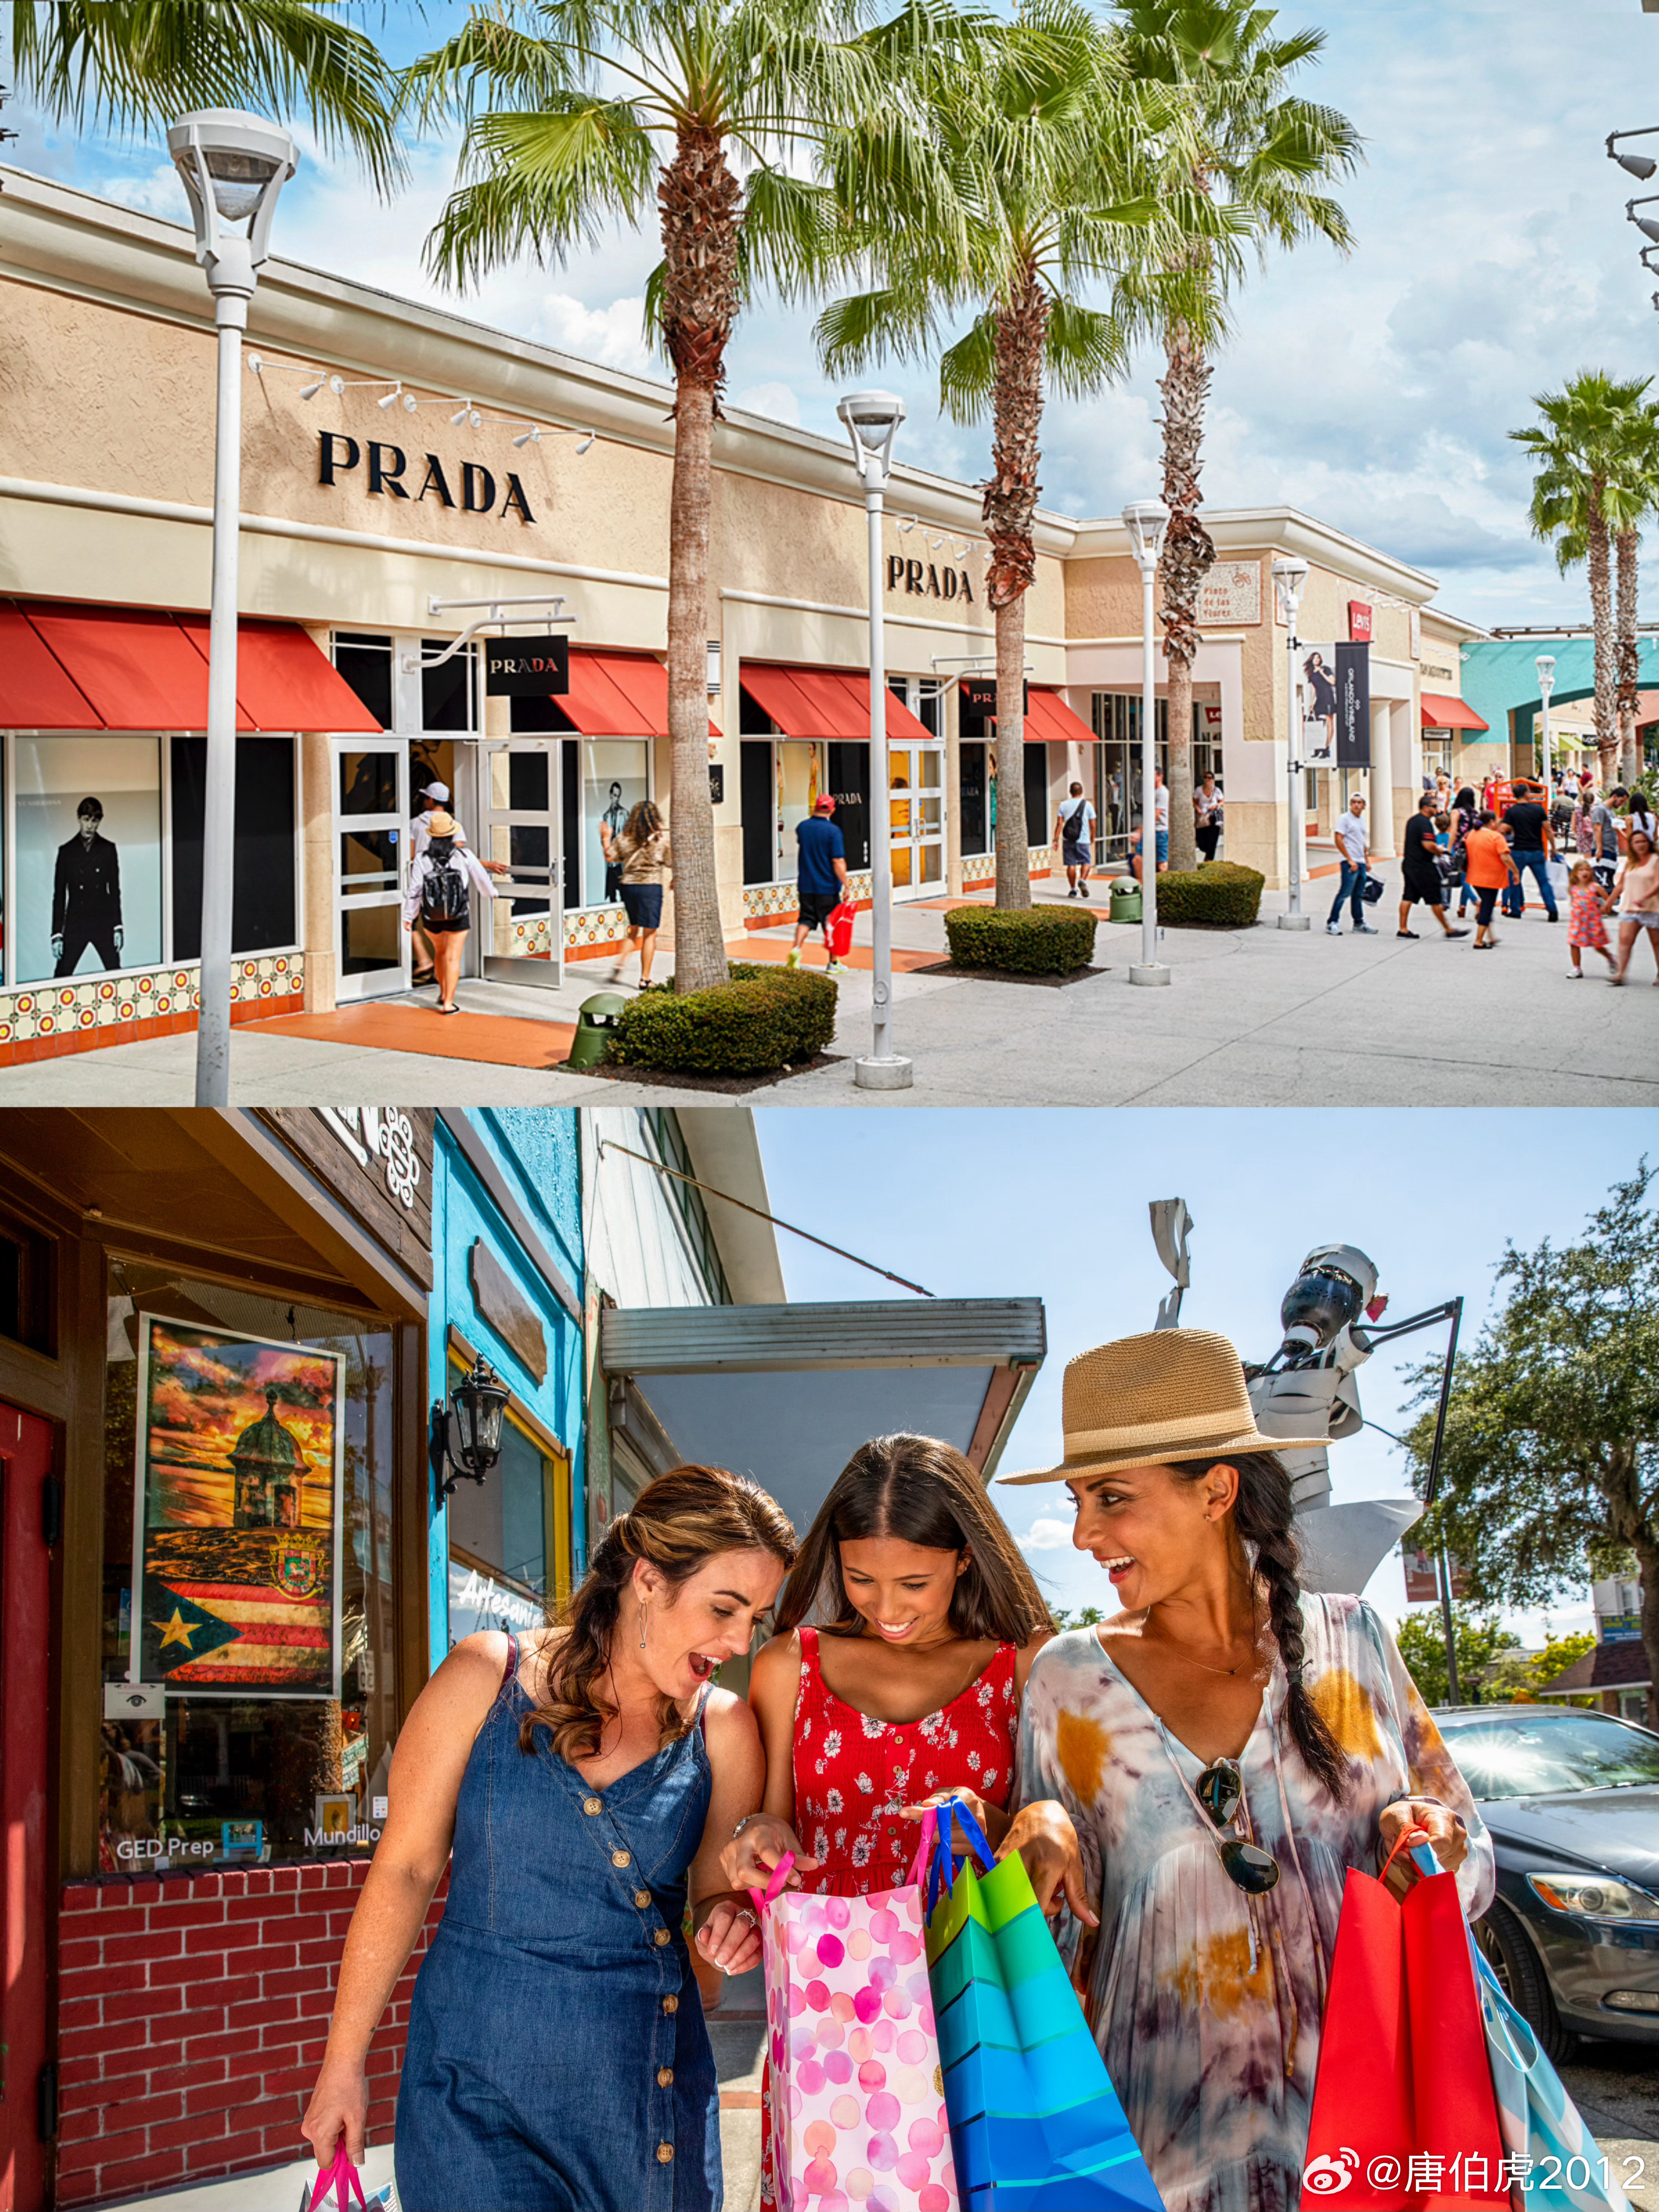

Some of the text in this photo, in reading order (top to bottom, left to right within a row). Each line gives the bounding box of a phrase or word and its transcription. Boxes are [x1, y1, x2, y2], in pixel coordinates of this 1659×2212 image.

[318, 430, 537, 524] PRADA
[888, 555, 974, 602] PRADA
[490, 657, 559, 674] PRADA
[304, 1823, 381, 1847] Mundillo
[117, 1838, 214, 1859] GED Prep
